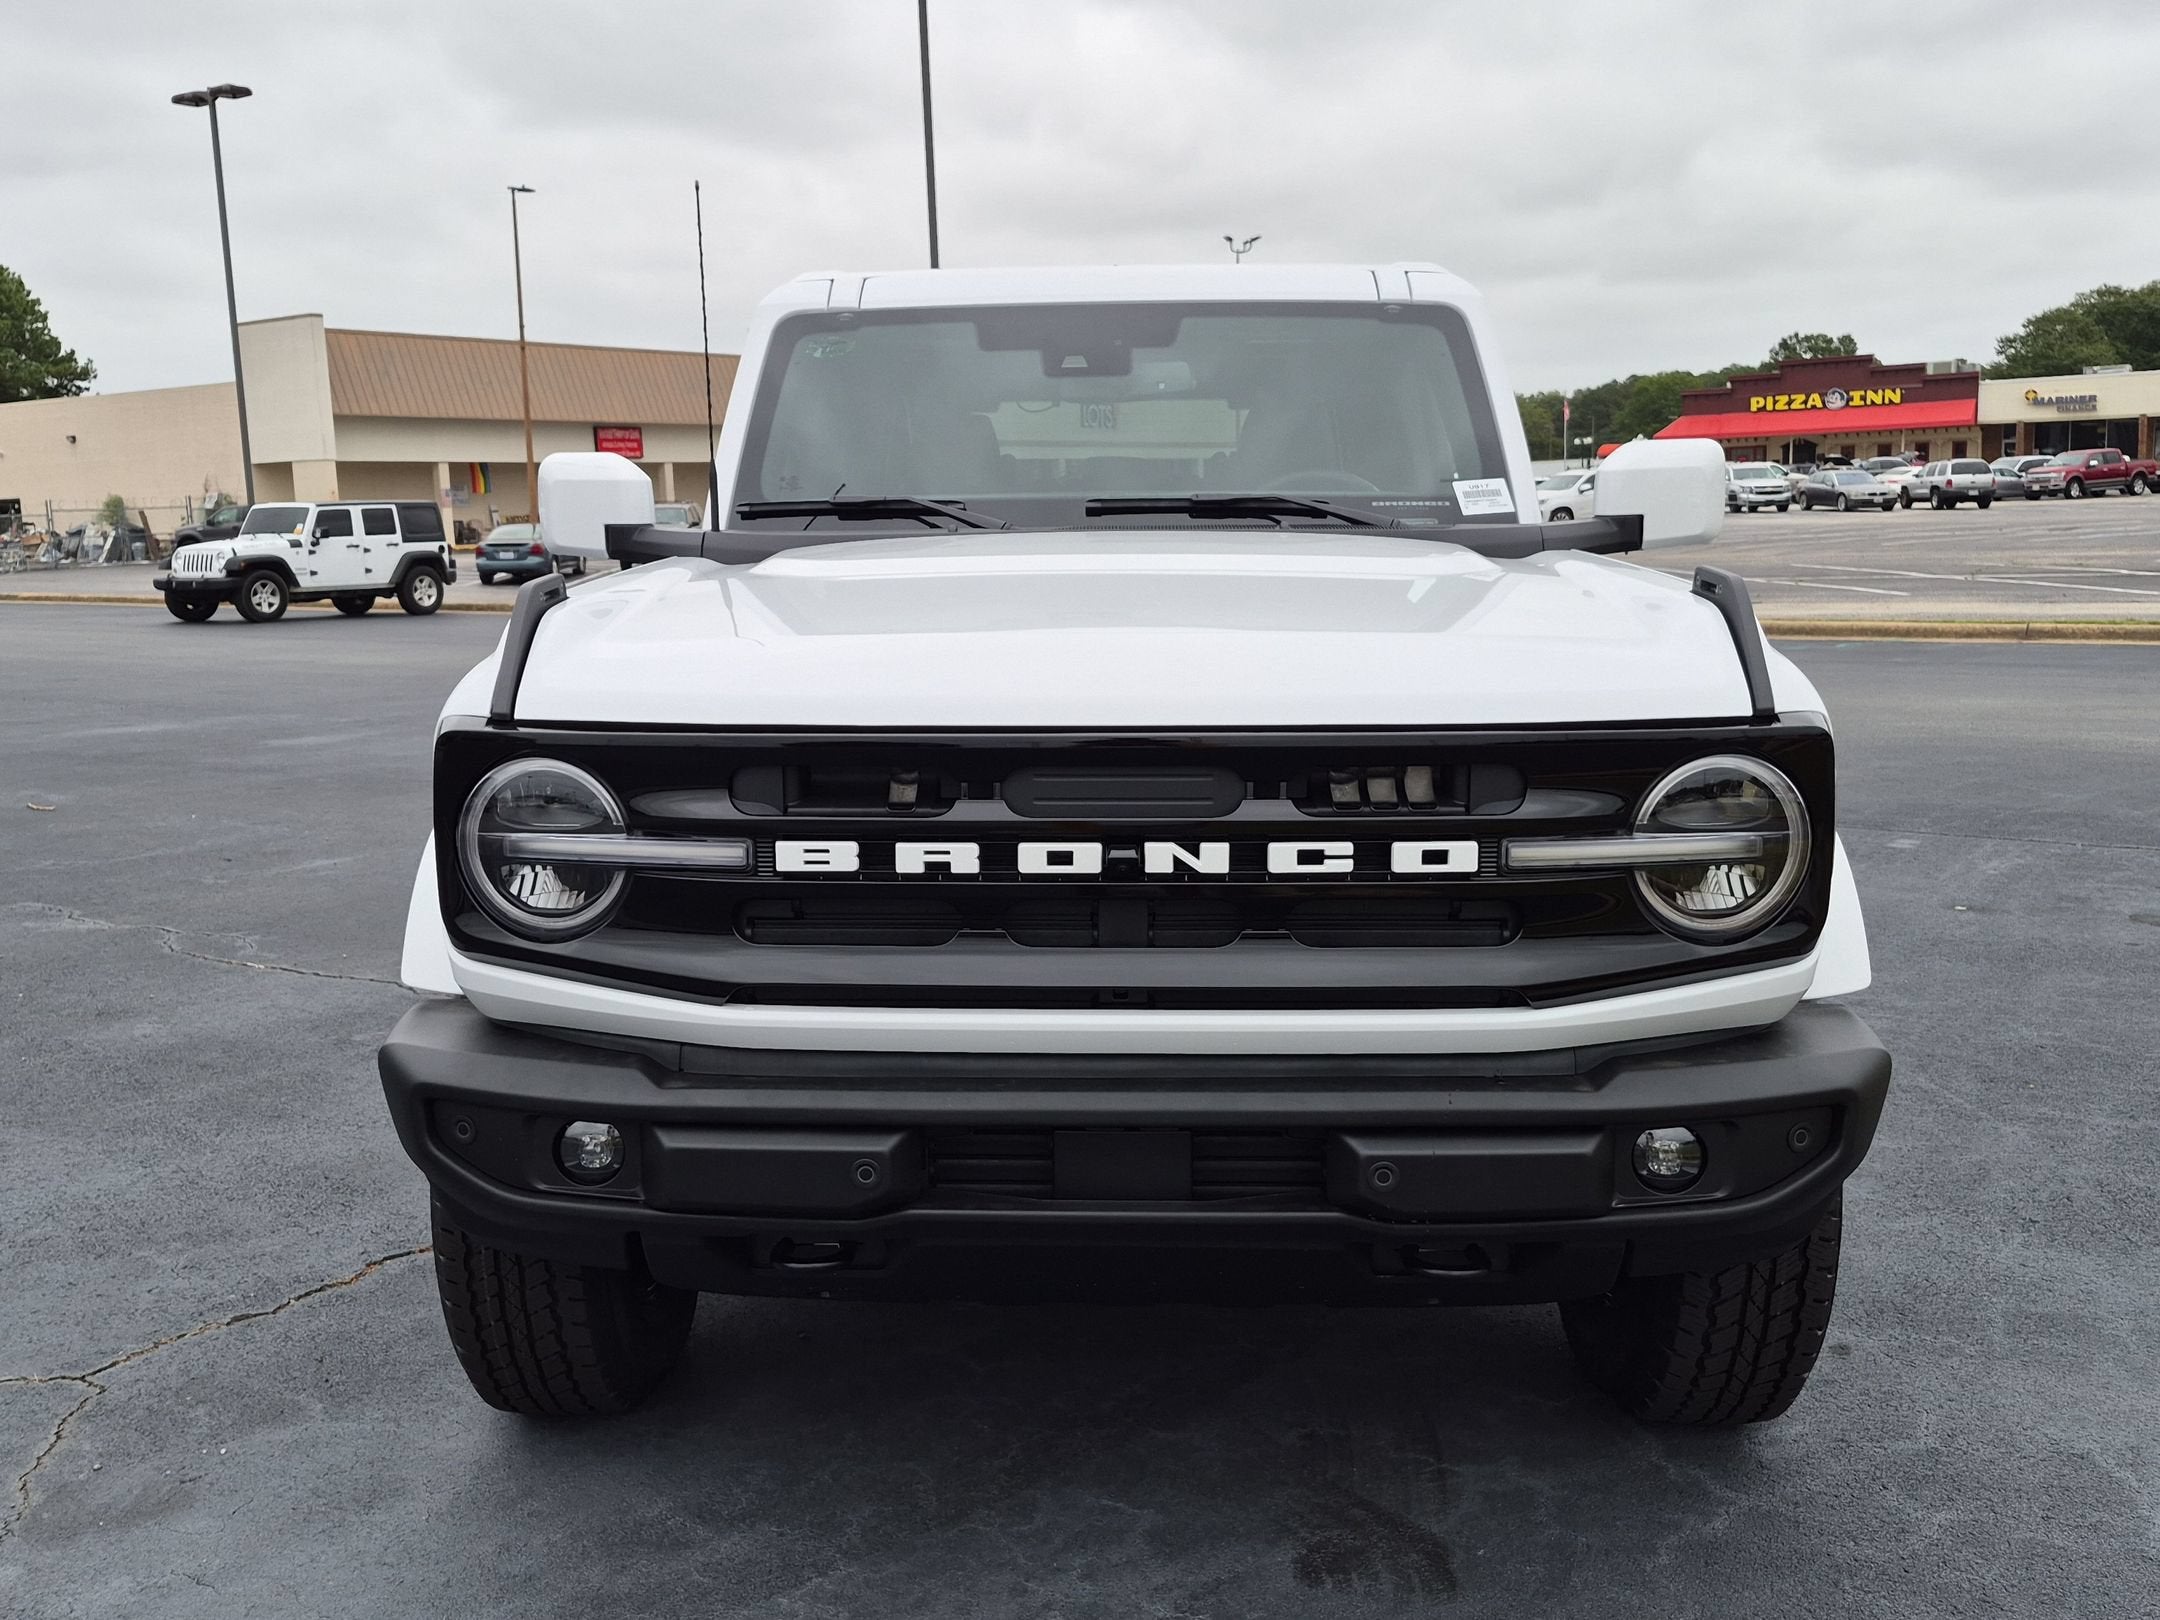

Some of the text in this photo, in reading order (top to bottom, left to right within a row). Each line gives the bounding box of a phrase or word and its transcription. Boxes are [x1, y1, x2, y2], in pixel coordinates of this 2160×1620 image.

[1750, 388, 1901, 411] PIZZA INN
[2033, 395, 2097, 405] MARINER
[775, 840, 1479, 874] BRONCO
